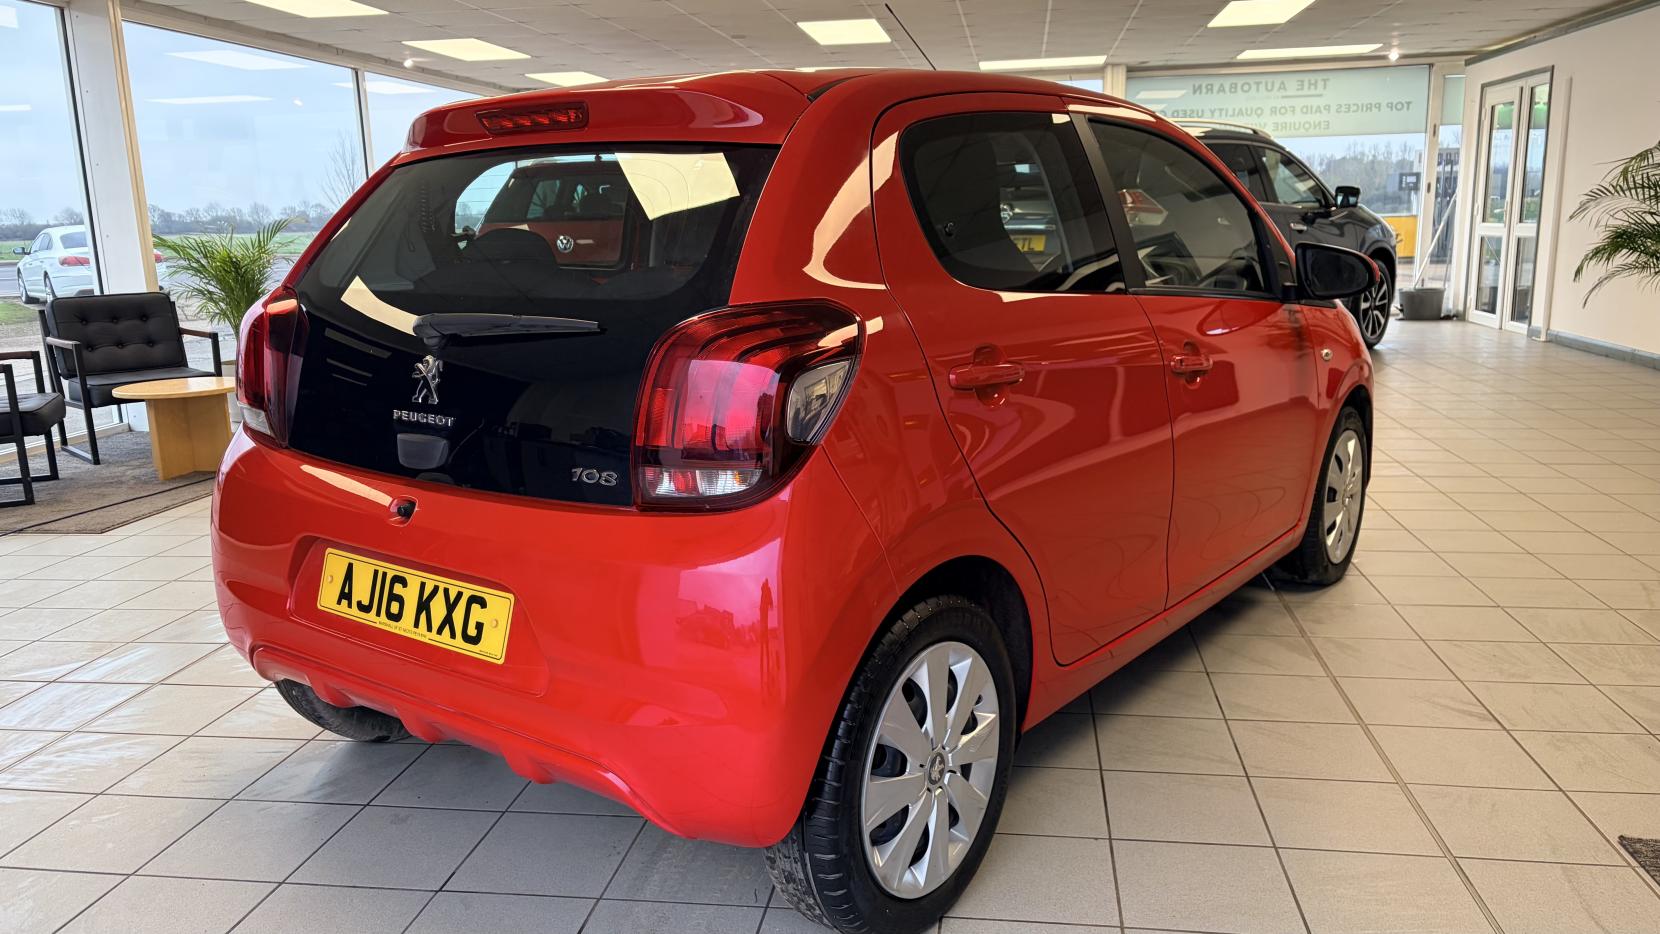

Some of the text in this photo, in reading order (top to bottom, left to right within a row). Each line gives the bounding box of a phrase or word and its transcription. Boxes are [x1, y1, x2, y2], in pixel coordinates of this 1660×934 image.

[393, 409, 455, 427] PEUGEOT
[571, 467, 617, 486] 108
[336, 562, 488, 646] AJ16 KXG
